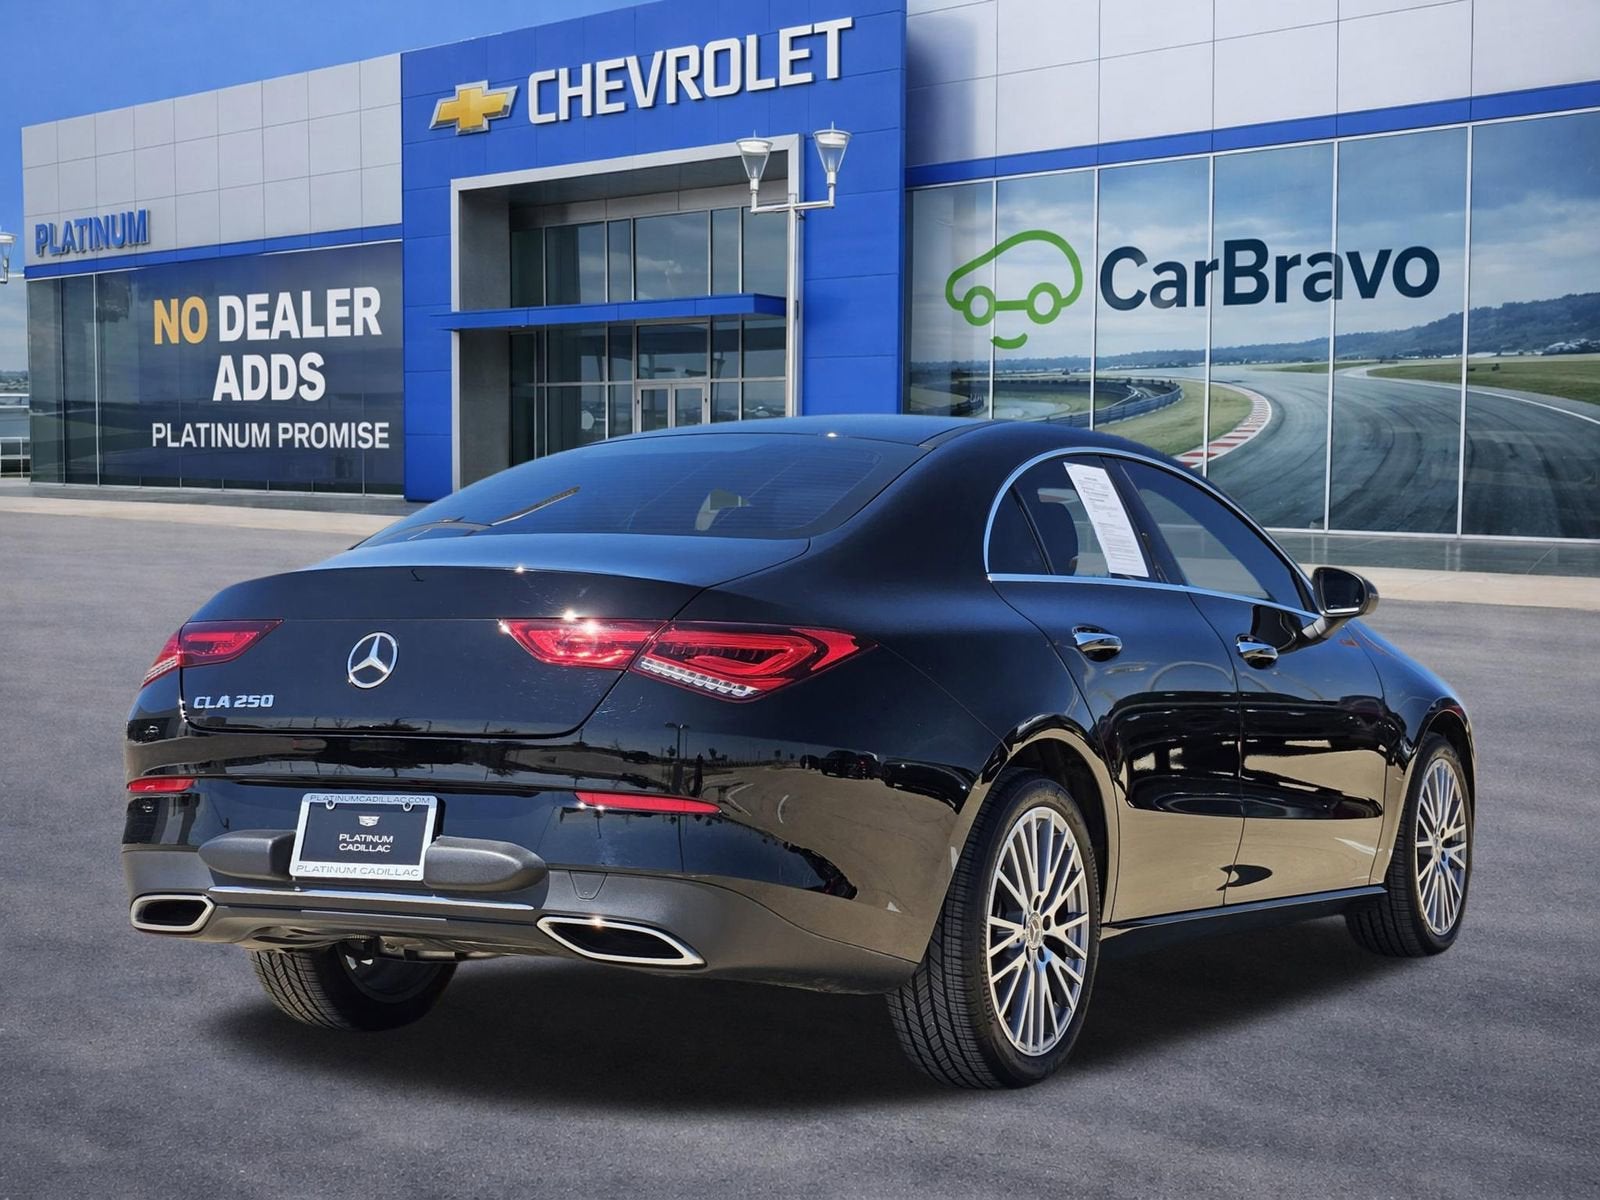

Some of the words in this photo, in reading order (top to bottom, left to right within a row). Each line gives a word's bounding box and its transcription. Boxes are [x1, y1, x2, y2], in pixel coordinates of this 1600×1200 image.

[528, 17, 854, 125] CHEVROLET
[35, 208, 151, 257] PLATINUM
[1100, 238, 1440, 311] CarBravo
[153, 296, 208, 345] NO
[218, 286, 382, 342] DEALER
[212, 352, 326, 401] ADDS
[152, 422, 271, 448] PLATINUM
[278, 421, 390, 449] PROMISE
[193, 695, 231, 709] CLA
[233, 694, 275, 708] 250
[338, 833, 394, 843] PLATINUM
[338, 843, 391, 853] CADILLAC
[296, 864, 358, 875] PLATINUM
[359, 866, 420, 877] CADILLAC
